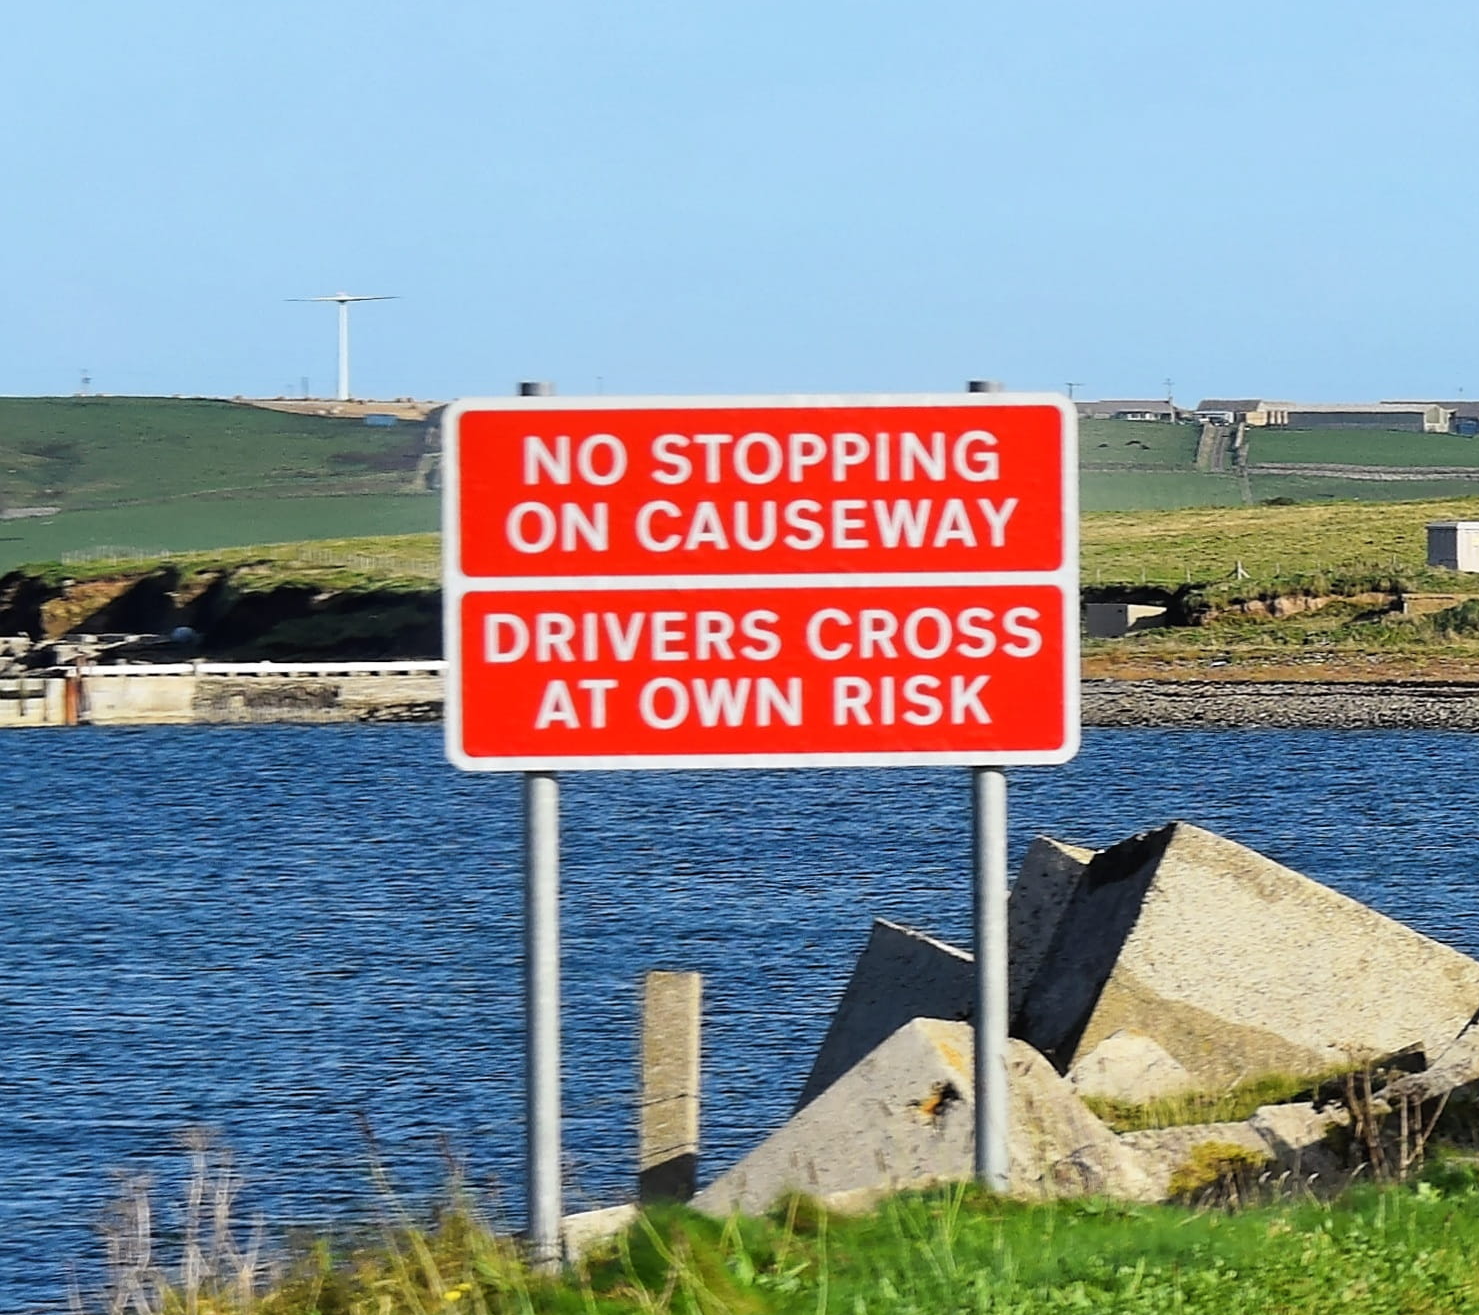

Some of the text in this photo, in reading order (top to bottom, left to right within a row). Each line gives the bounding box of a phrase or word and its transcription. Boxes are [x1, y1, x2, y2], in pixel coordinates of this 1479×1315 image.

[525, 430, 999, 485] NO STOPPING
[507, 498, 1018, 553] ON CAUSEWAY
[485, 607, 1042, 663] DRIVERS CROSS
[535, 675, 992, 729] AT OWN RISK
